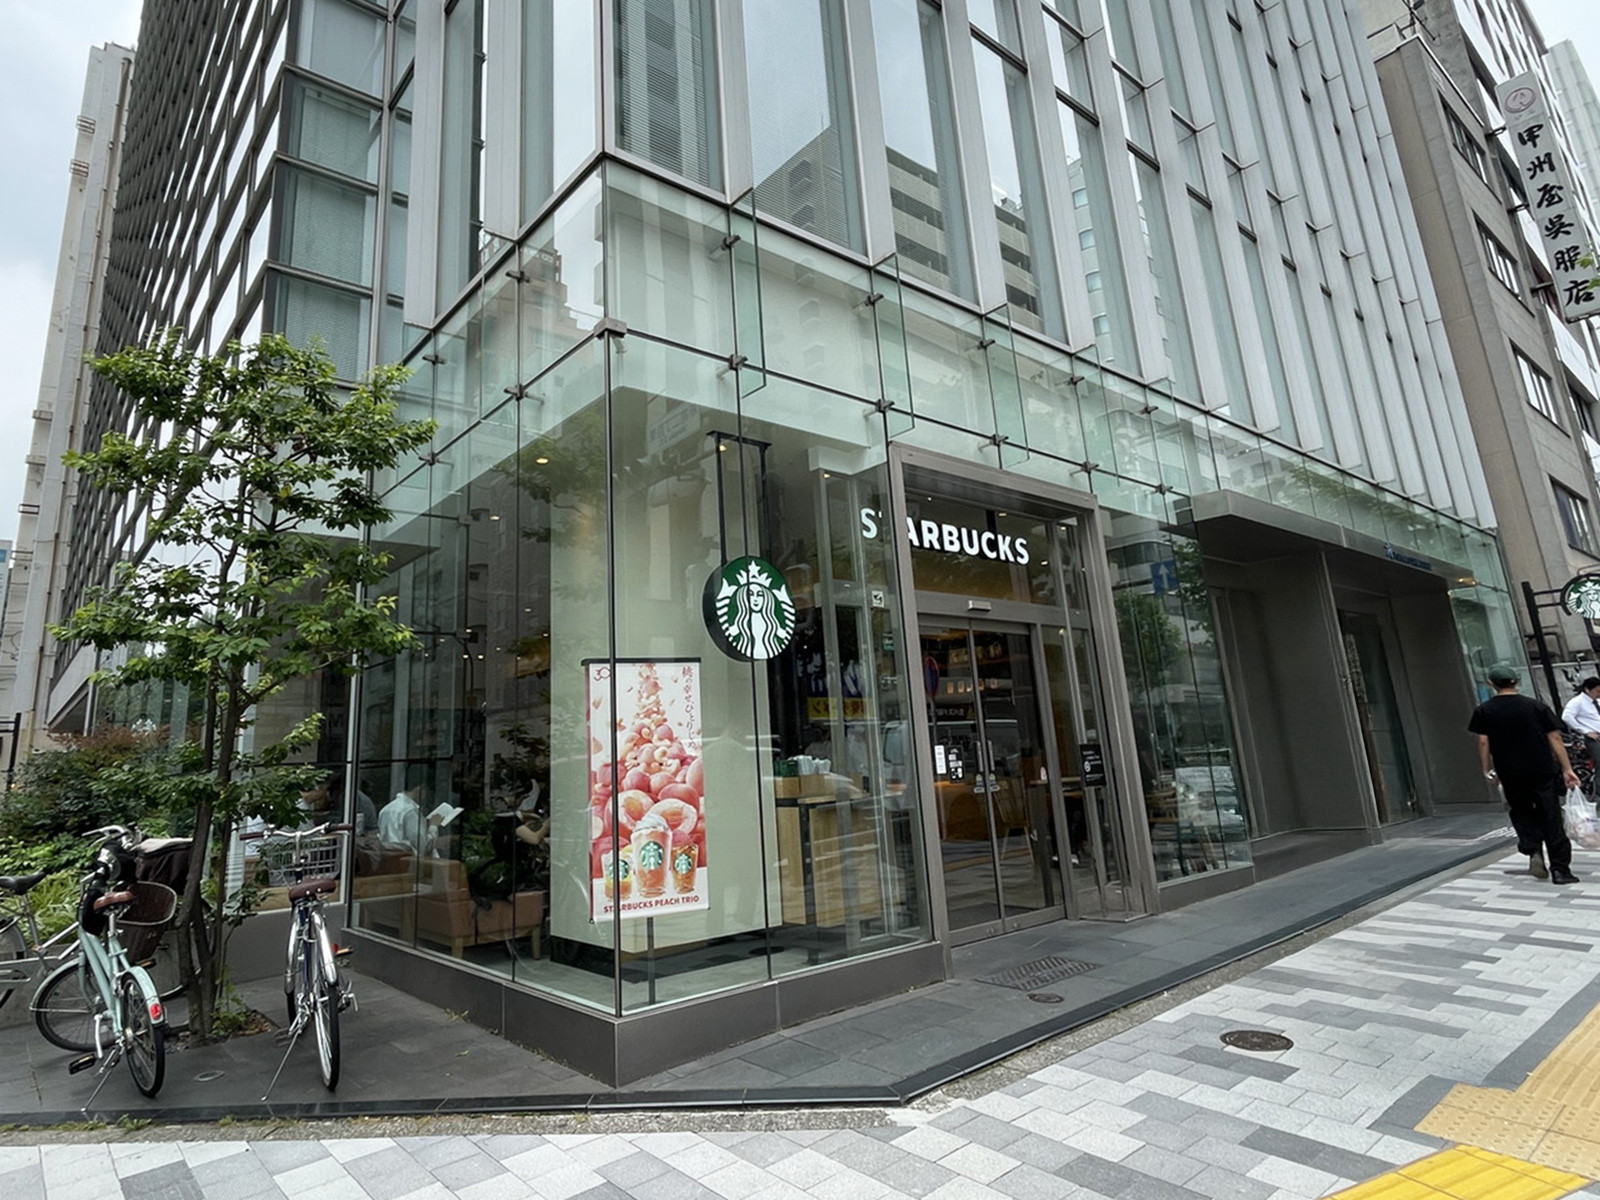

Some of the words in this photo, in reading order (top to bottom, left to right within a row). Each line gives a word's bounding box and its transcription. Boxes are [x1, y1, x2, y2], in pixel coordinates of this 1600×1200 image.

[860, 507, 1030, 565] SARBUCKS
[603, 900, 653, 913] STRBUCKS
[654, 897, 681, 907] PEACH
[681, 895, 700, 904] TRIO
